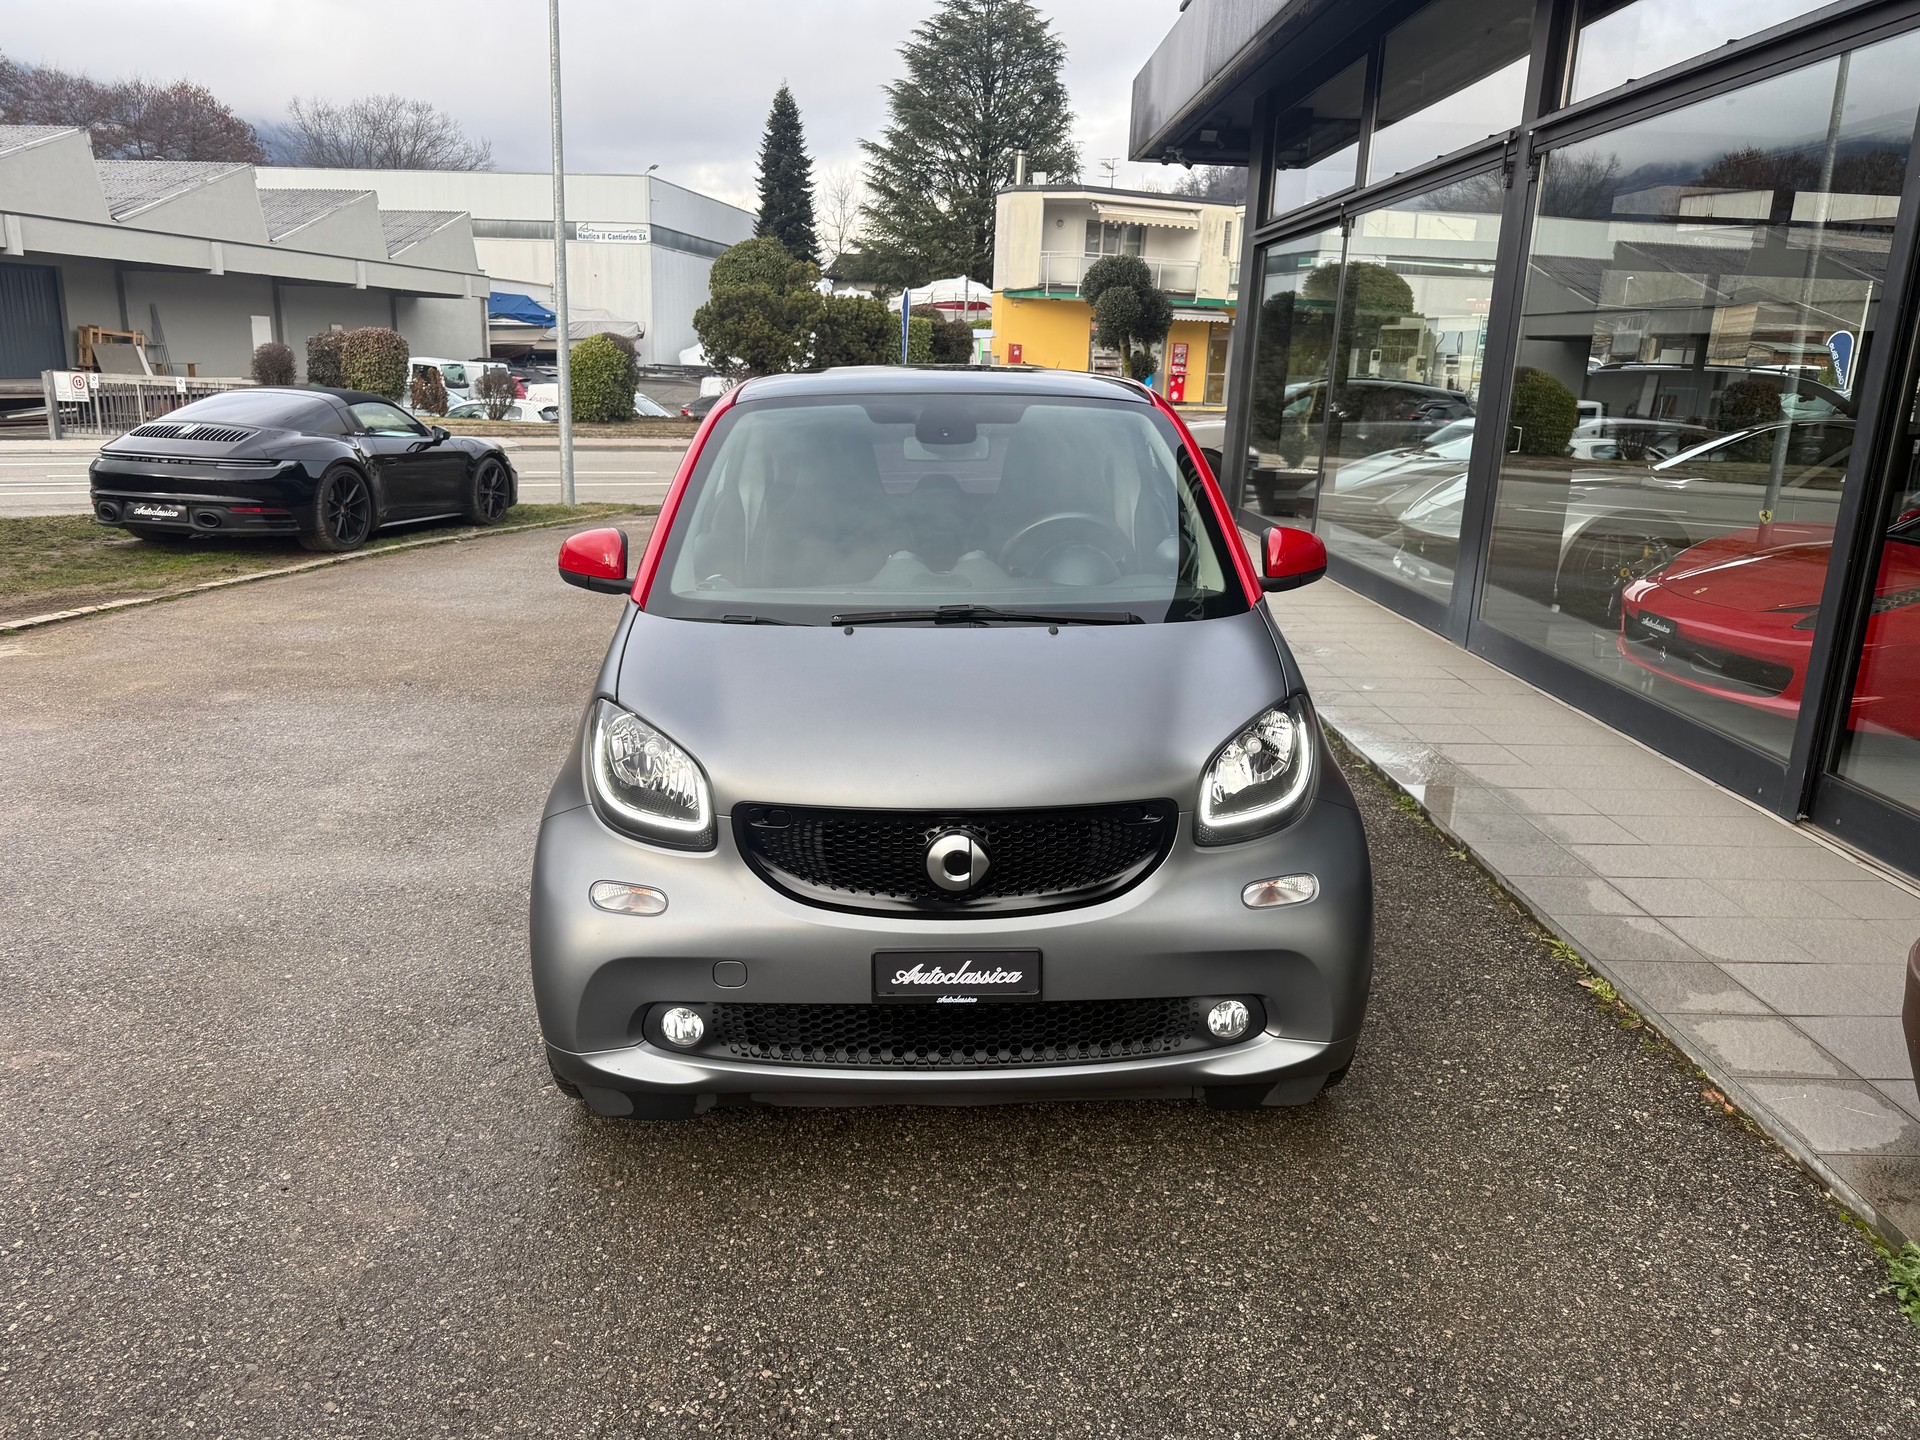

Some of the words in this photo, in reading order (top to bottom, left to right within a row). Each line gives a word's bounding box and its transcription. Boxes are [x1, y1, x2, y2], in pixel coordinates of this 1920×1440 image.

[133, 505, 179, 518] Autoclassica
[1641, 616, 1671, 634] Autoclassica
[891, 960, 1023, 985] Autoclassica
[936, 995, 978, 1004] Autoclassica
